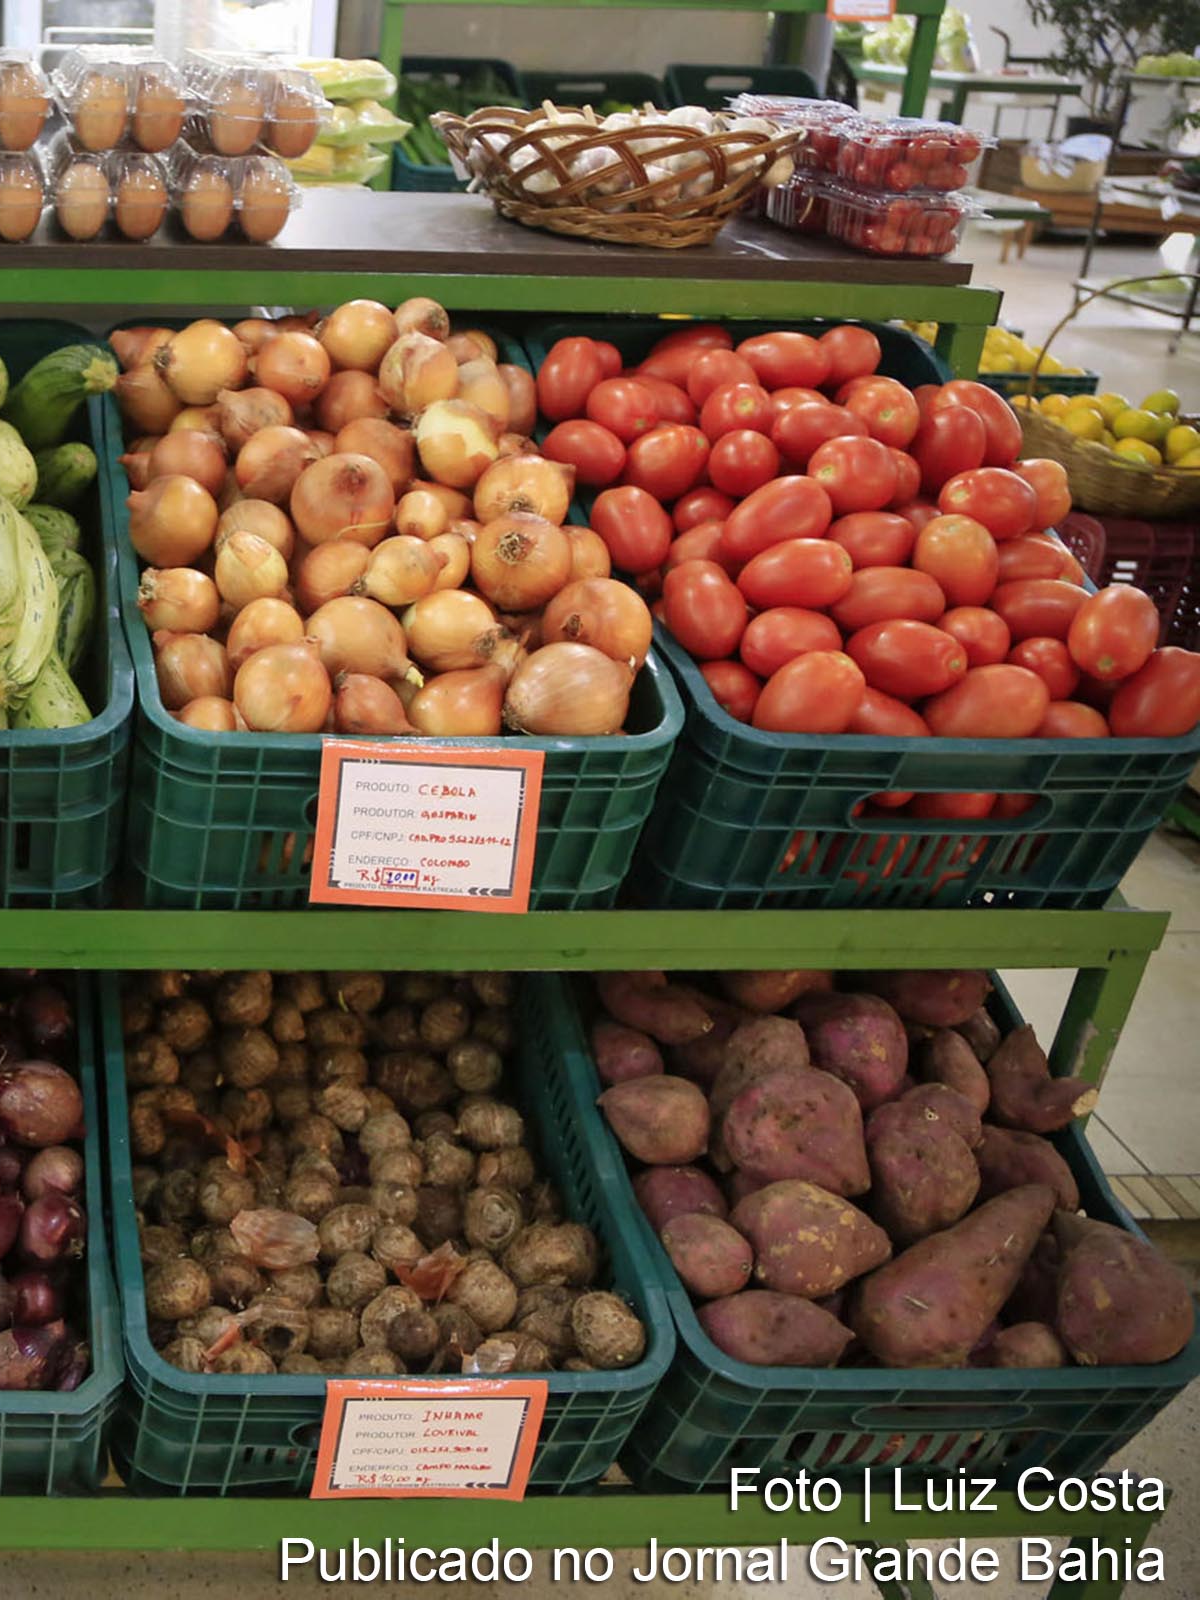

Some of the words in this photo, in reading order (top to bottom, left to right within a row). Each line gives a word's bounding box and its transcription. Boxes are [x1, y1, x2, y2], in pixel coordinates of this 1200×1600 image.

[419, 784, 477, 799] CEBOLA
[420, 857, 470, 868] COLOMBO
[356, 869, 381, 883] R$
[422, 1411, 484, 1423] INHAME
[356, 1474, 377, 1485] R$
